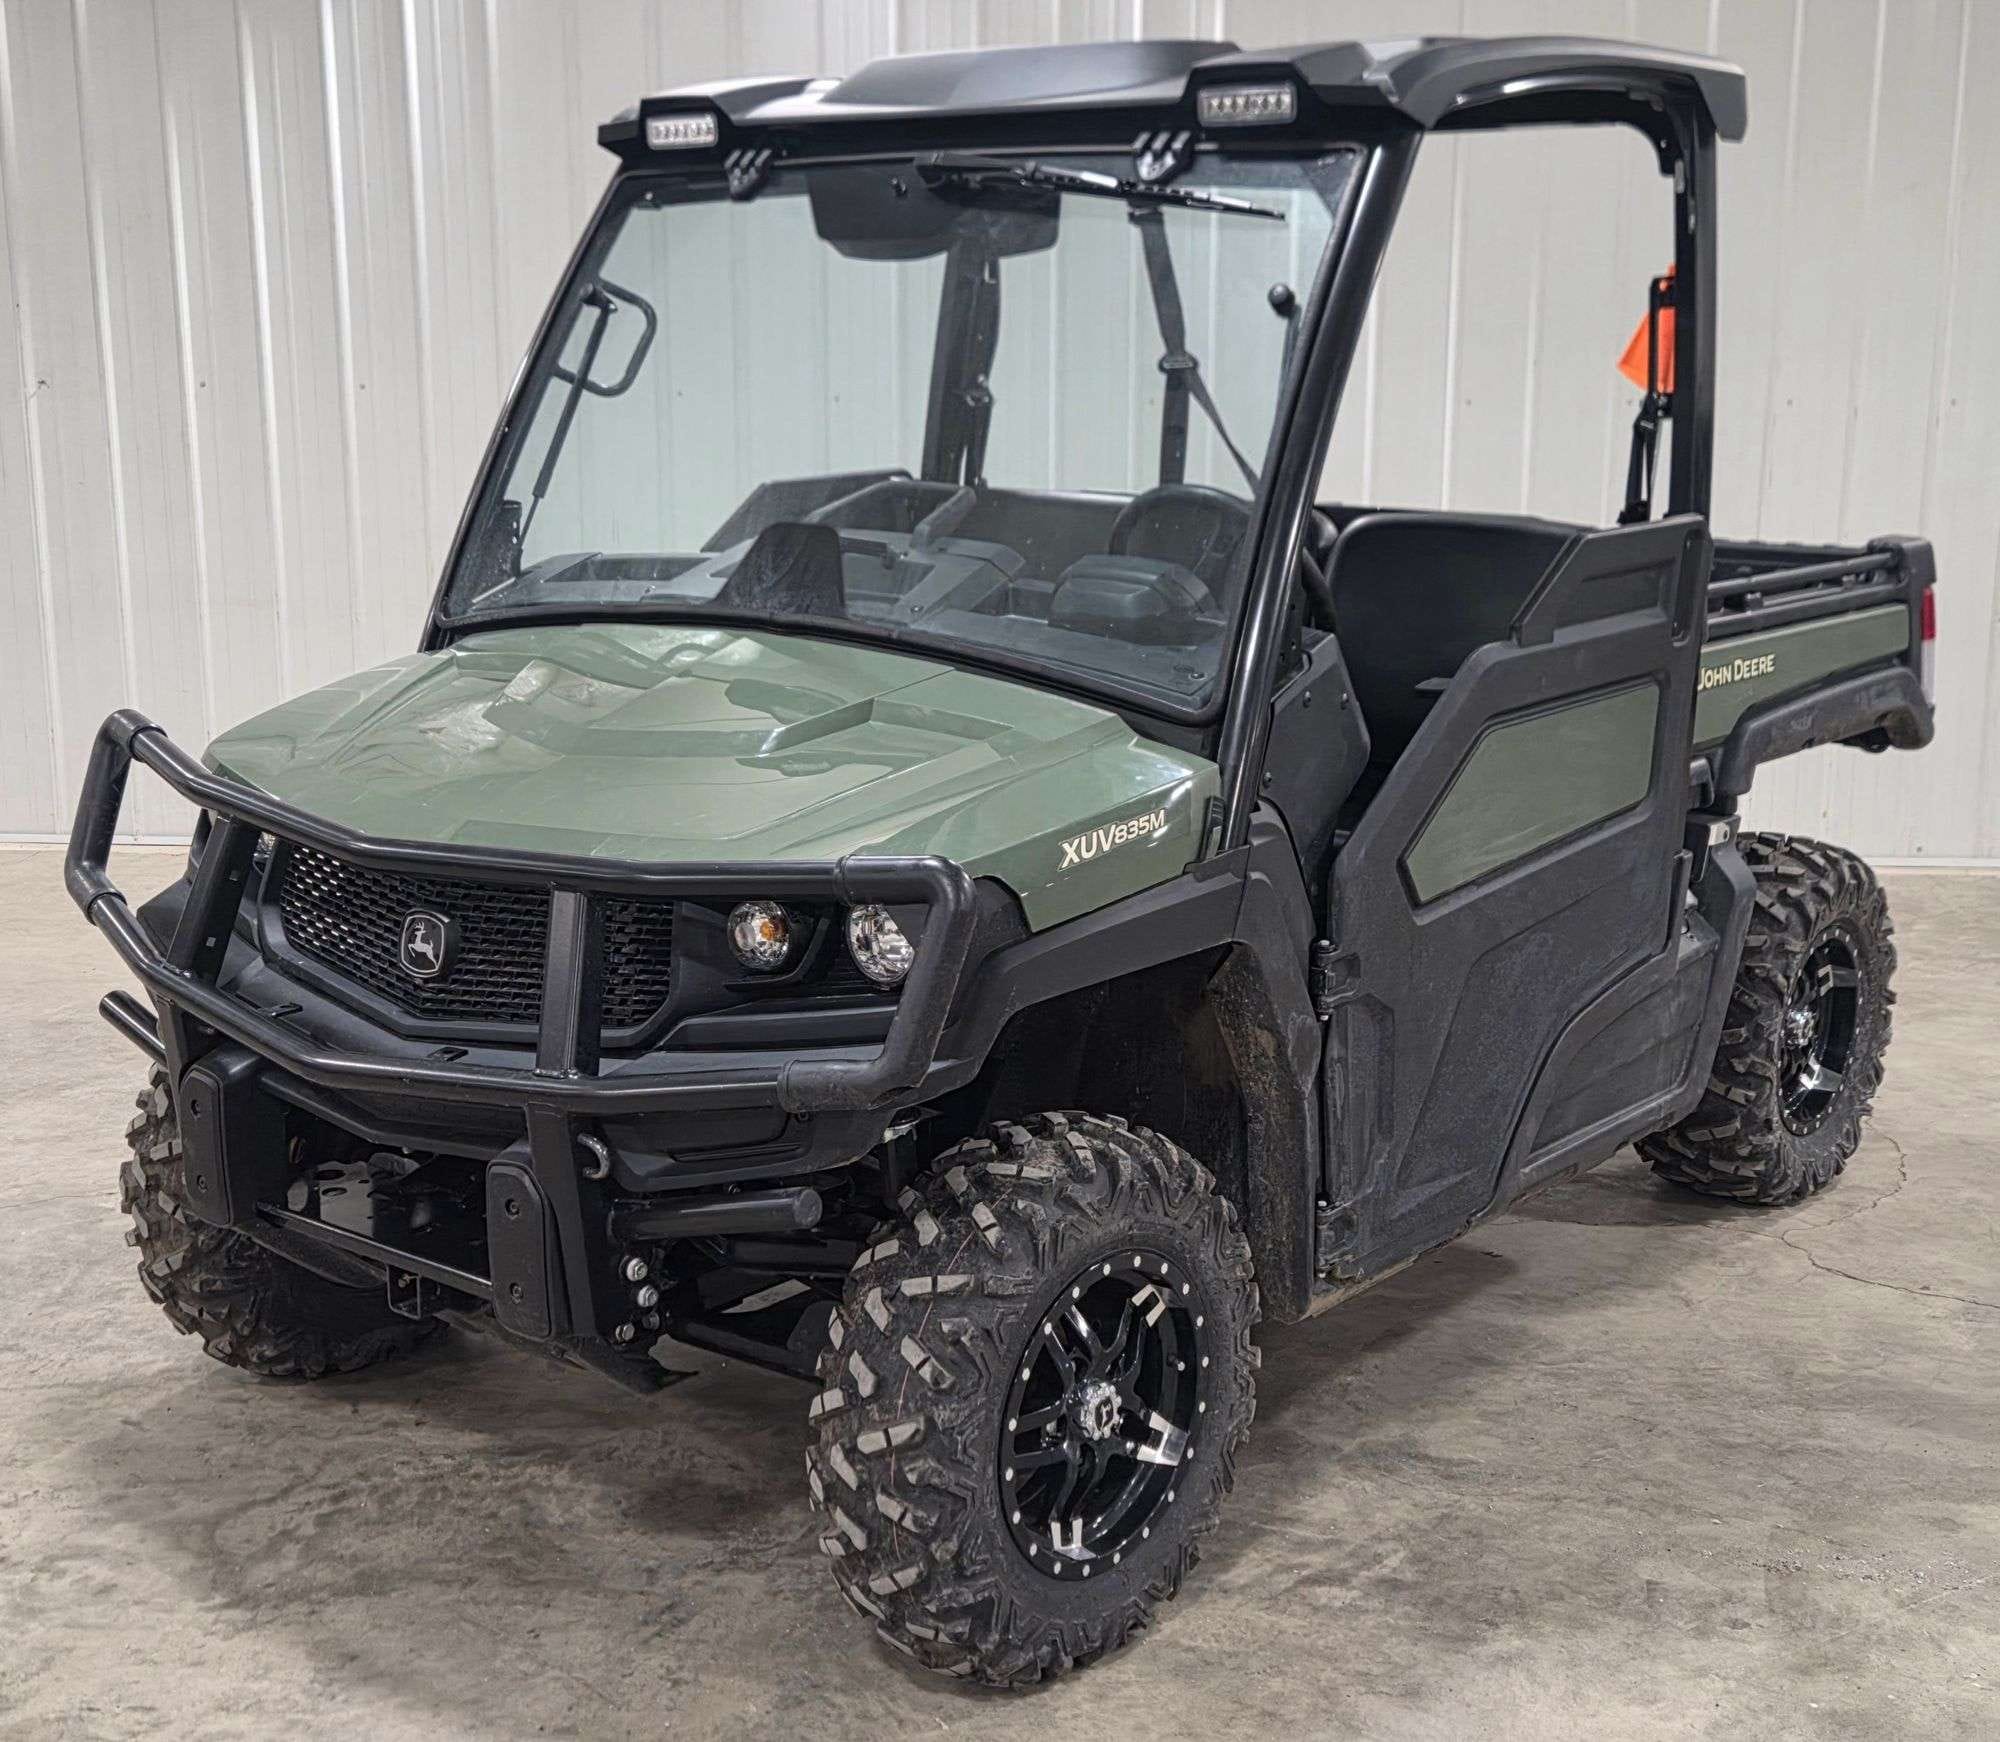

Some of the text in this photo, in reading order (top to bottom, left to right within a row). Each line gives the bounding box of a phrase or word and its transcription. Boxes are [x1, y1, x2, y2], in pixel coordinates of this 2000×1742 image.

[1697, 653, 1776, 691] JOHN DEERE
[1060, 808, 1167, 869] XUV835M
